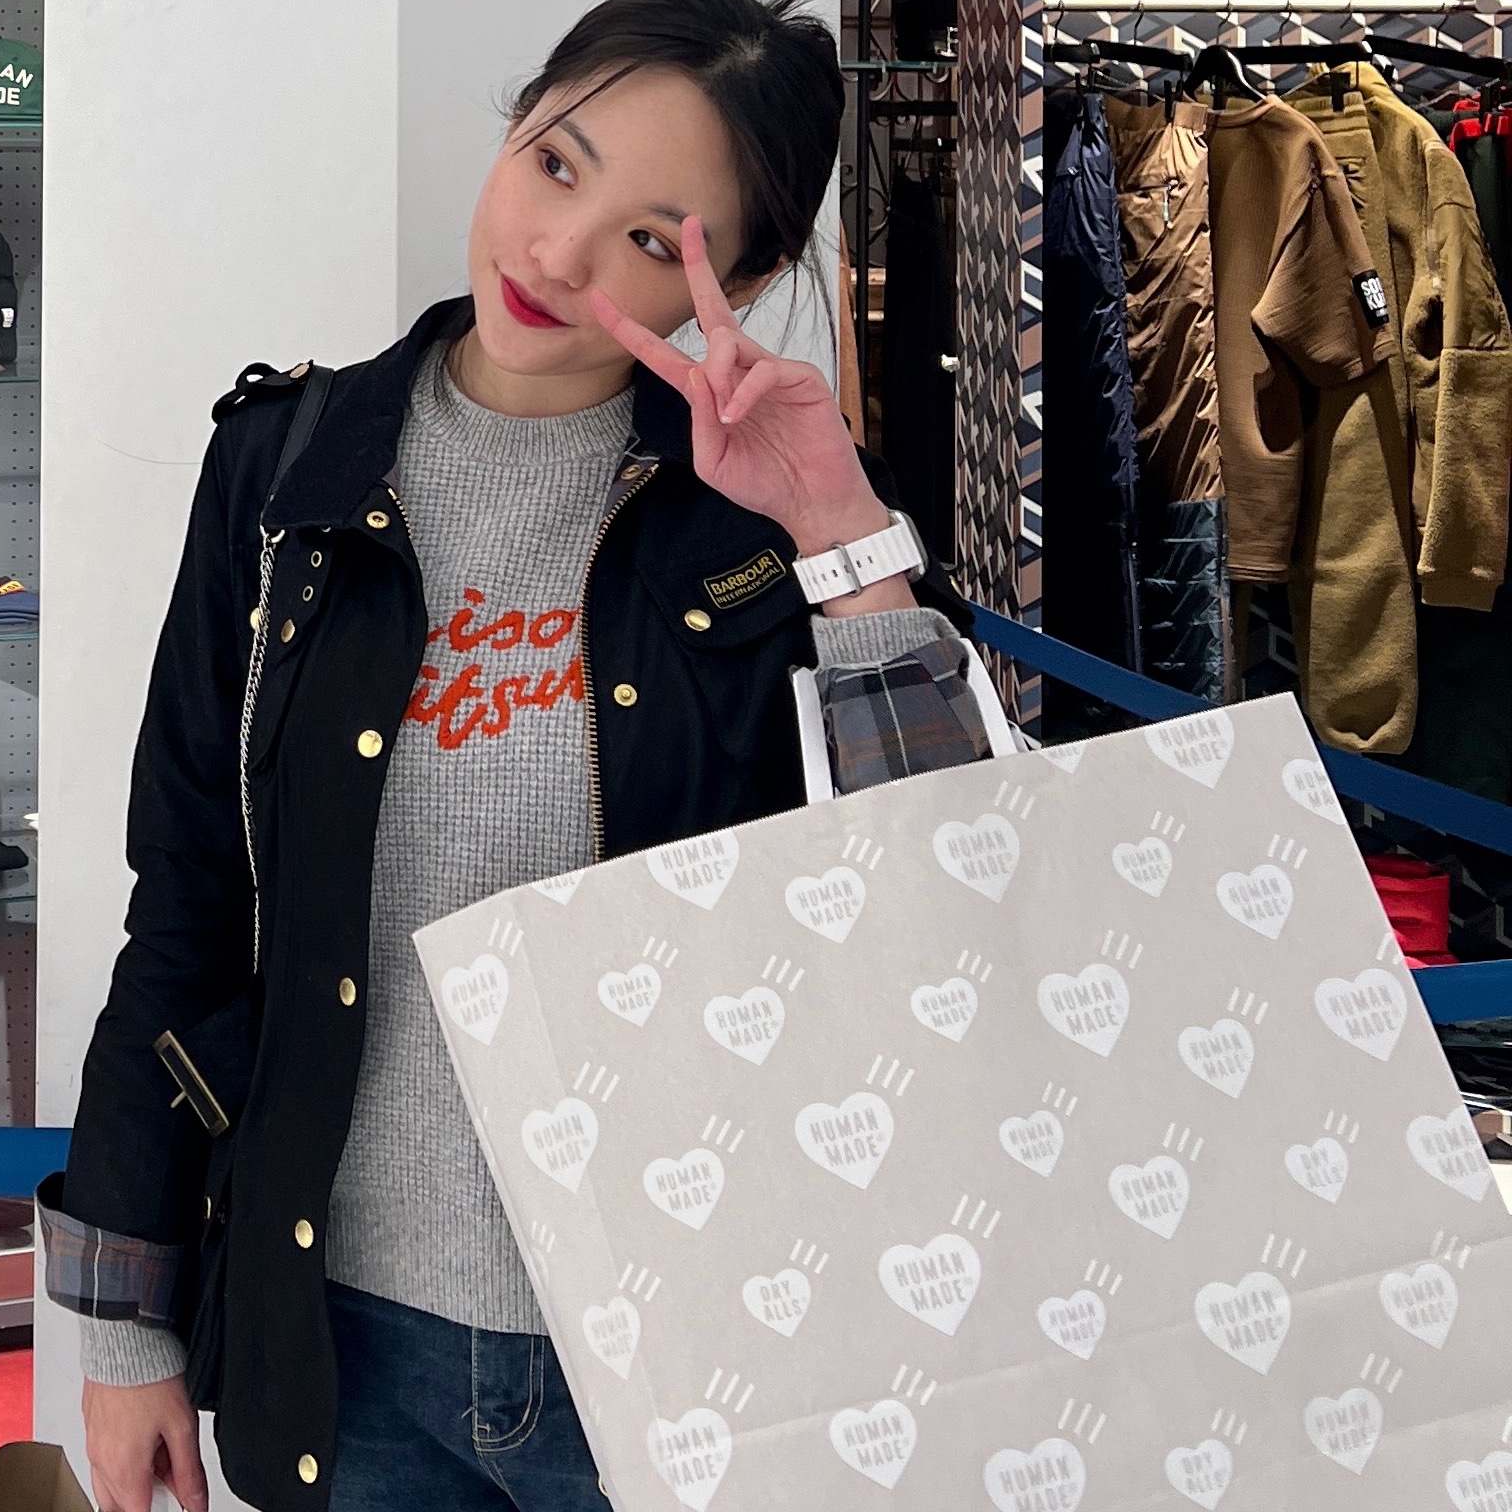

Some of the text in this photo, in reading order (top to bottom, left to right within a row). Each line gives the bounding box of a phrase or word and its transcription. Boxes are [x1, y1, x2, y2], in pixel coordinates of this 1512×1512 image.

[710, 556, 774, 595] BARBOUR
[425, 587, 583, 654] iso
[1158, 716, 1220, 748] HUMAN
[659, 838, 726, 870] HUMAN
[948, 830, 1007, 858] HUMAN
[798, 879, 853, 909] HUMAN
[1230, 878, 1280, 904] HUMAN
[451, 971, 499, 1006] HUMAN
[608, 976, 652, 999] HUMAN
[921, 990, 967, 1012] HUMAN
[1051, 983, 1117, 1014] HUMAN
[1329, 984, 1394, 1017] HUMAN
[716, 1001, 774, 1028] HUMAN
[1191, 1035, 1244, 1060] HUMAN
[533, 1114, 584, 1149] HUMAN
[810, 1107, 879, 1144] HUMAN
[1009, 1123, 1053, 1145] HUMAN
[656, 1164, 714, 1191] HUMAN
[1122, 1171, 1176, 1200] HUMAN
[894, 1252, 965, 1288] HUMAN
[759, 1280, 791, 1303] DRY
[1211, 1291, 1276, 1325] HUMAN
[844, 1416, 903, 1447] HUMAN
[1000, 1457, 1071, 1494] HUMAN
